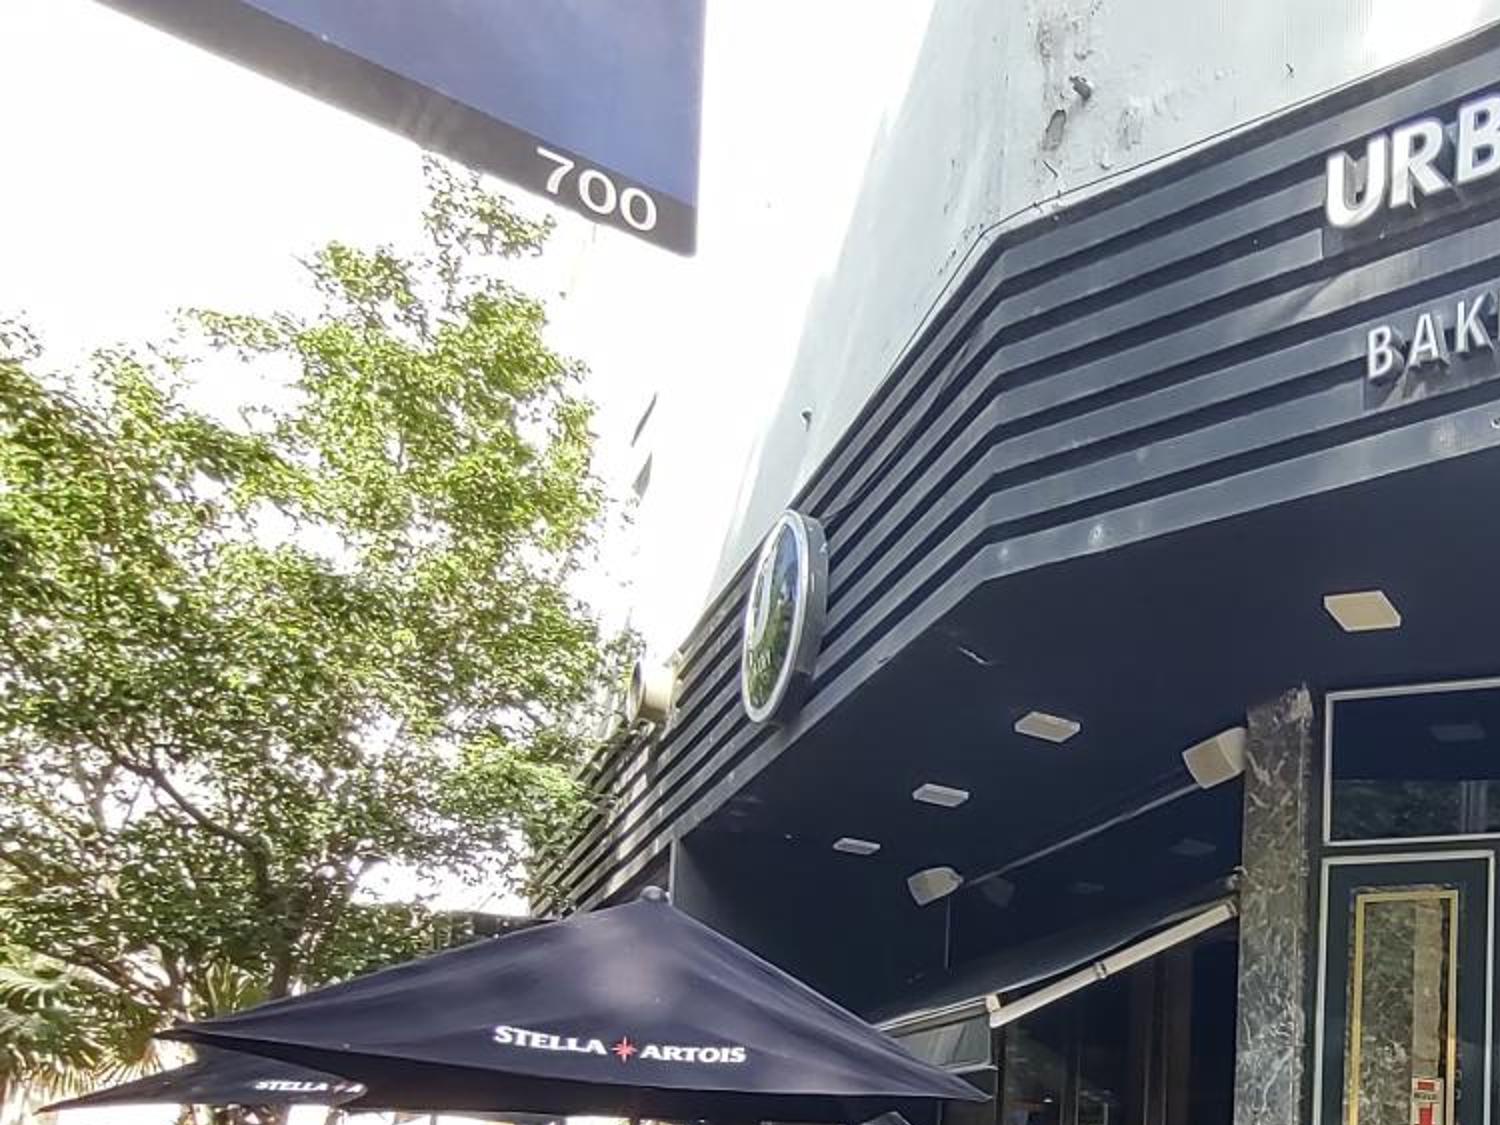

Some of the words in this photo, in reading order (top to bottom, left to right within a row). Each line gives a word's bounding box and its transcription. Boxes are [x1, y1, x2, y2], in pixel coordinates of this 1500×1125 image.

[536, 146, 658, 231] 700
[493, 1025, 608, 1056] STELLA
[639, 1044, 748, 1064] ARTOIS
[256, 1081, 328, 1091] STELLA
